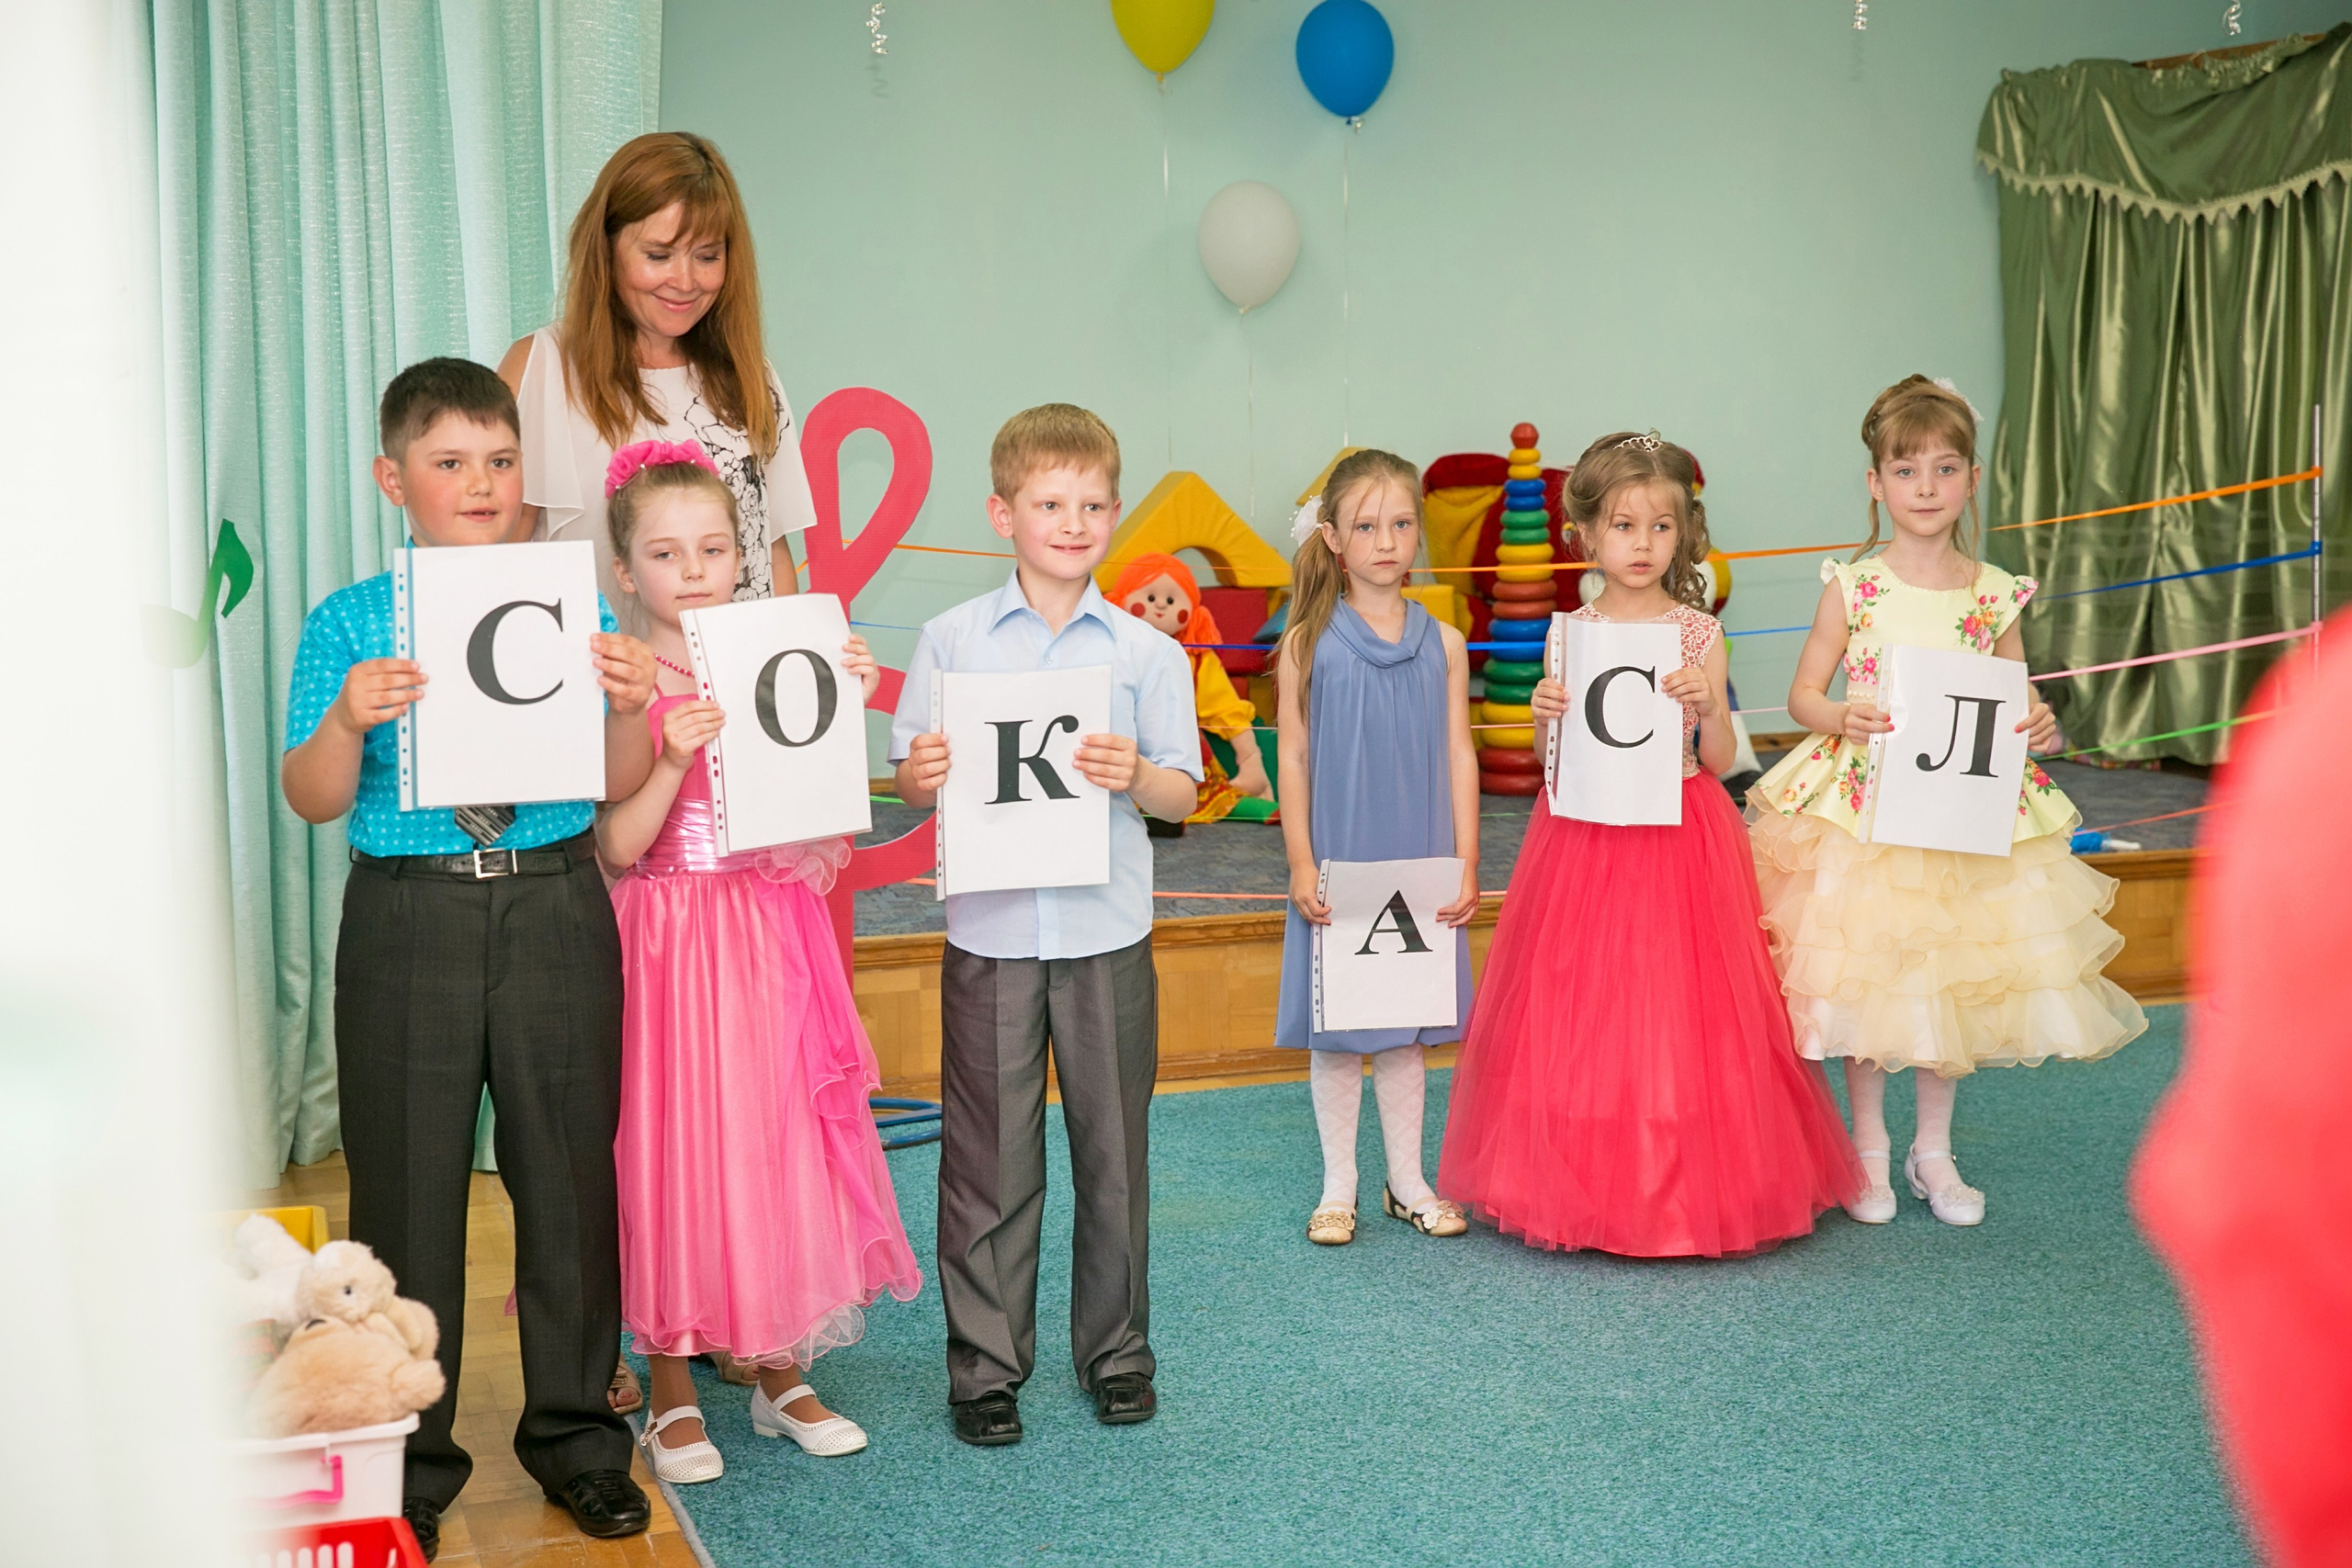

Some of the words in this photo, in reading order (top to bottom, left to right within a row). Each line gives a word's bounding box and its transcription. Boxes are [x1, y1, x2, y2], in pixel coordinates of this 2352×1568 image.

[467, 598, 563, 705] С
[754, 649, 838, 748] О
[1584, 665, 1656, 749] С
[1916, 694, 2007, 778] Л
[984, 714, 1080, 805] К
[1354, 889, 1433, 955] А
